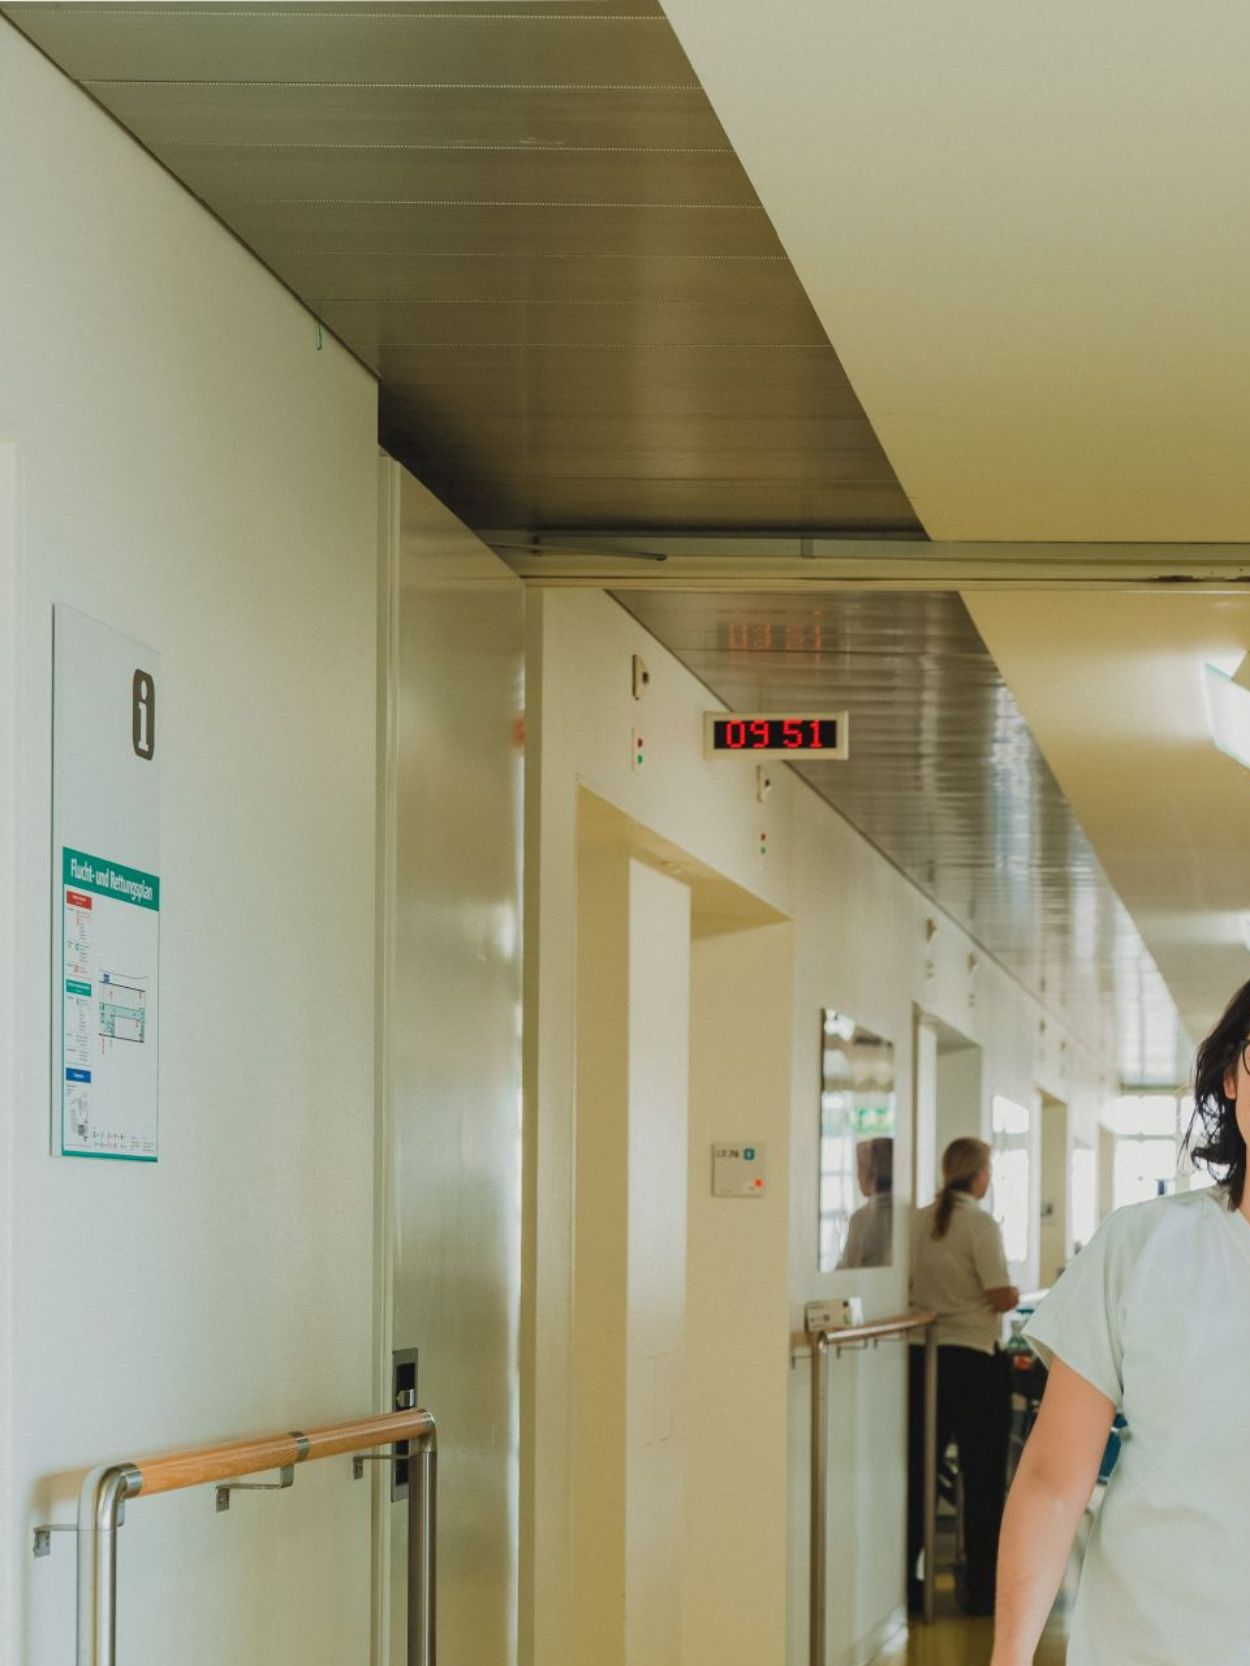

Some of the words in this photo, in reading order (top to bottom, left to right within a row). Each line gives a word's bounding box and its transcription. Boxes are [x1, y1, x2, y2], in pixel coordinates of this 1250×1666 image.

[70, 858, 95, 883] Flucht-
[95, 867, 109, 889] und
[110, 870, 153, 902] Rettungsplan
